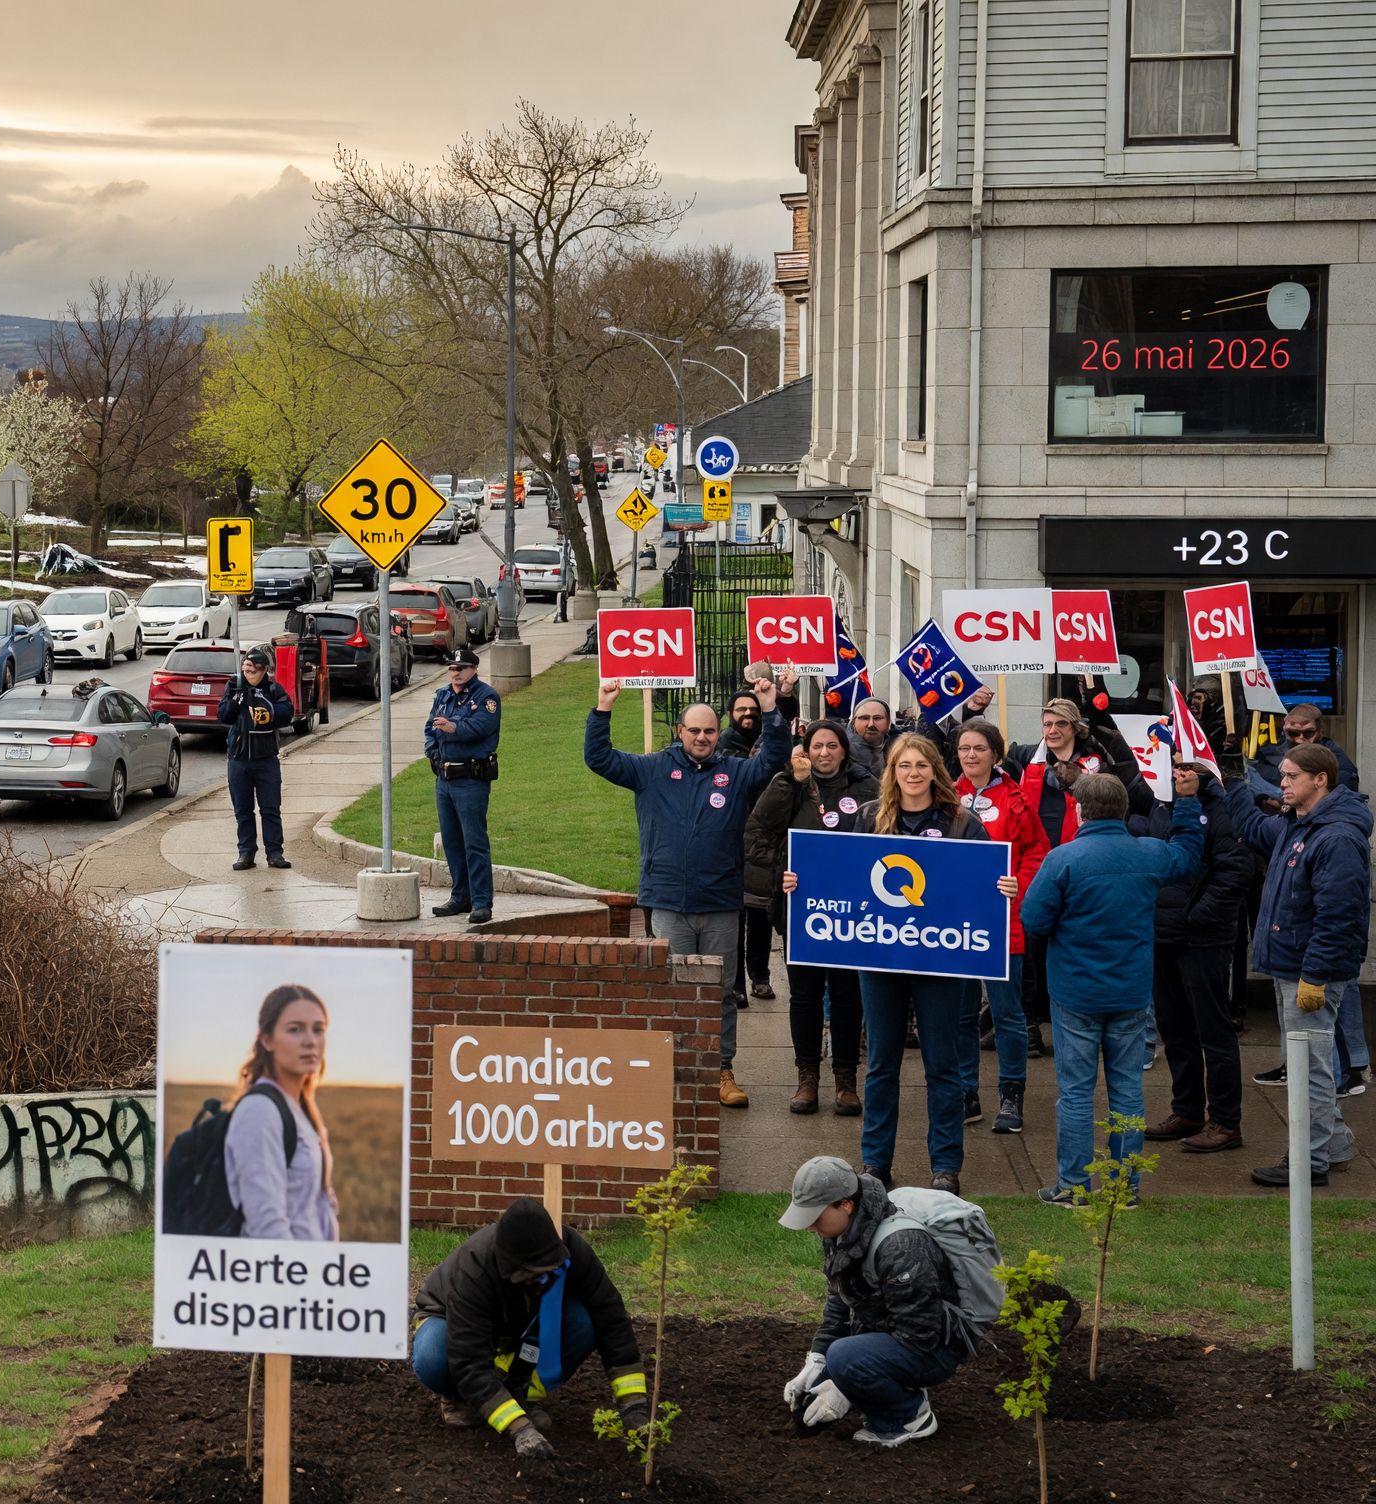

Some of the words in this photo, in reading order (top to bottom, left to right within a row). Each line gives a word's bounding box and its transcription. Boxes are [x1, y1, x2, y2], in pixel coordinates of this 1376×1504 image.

[1081, 339, 1121, 371] 26
[1134, 338, 1193, 371] mai
[1206, 337, 1291, 370] 2026
[350, 477, 417, 521] 30
[1172, 529, 1249, 566] +23
[1264, 529, 1289, 560] C
[755, 615, 825, 645] CSN
[953, 610, 1041, 643] CSN
[1055, 611, 1107, 642] CSN
[1193, 605, 1245, 641] CSN
[606, 628, 684, 658] CSN
[806, 897, 852, 914] PARTI
[805, 912, 991, 952] Québécois
[449, 1035, 614, 1087] Candiac
[447, 1100, 540, 1147] 1000
[544, 1104, 666, 1153] arbres
[188, 1249, 308, 1285] Alerte
[322, 1253, 371, 1288] de
[174, 1292, 386, 1336] disparition
